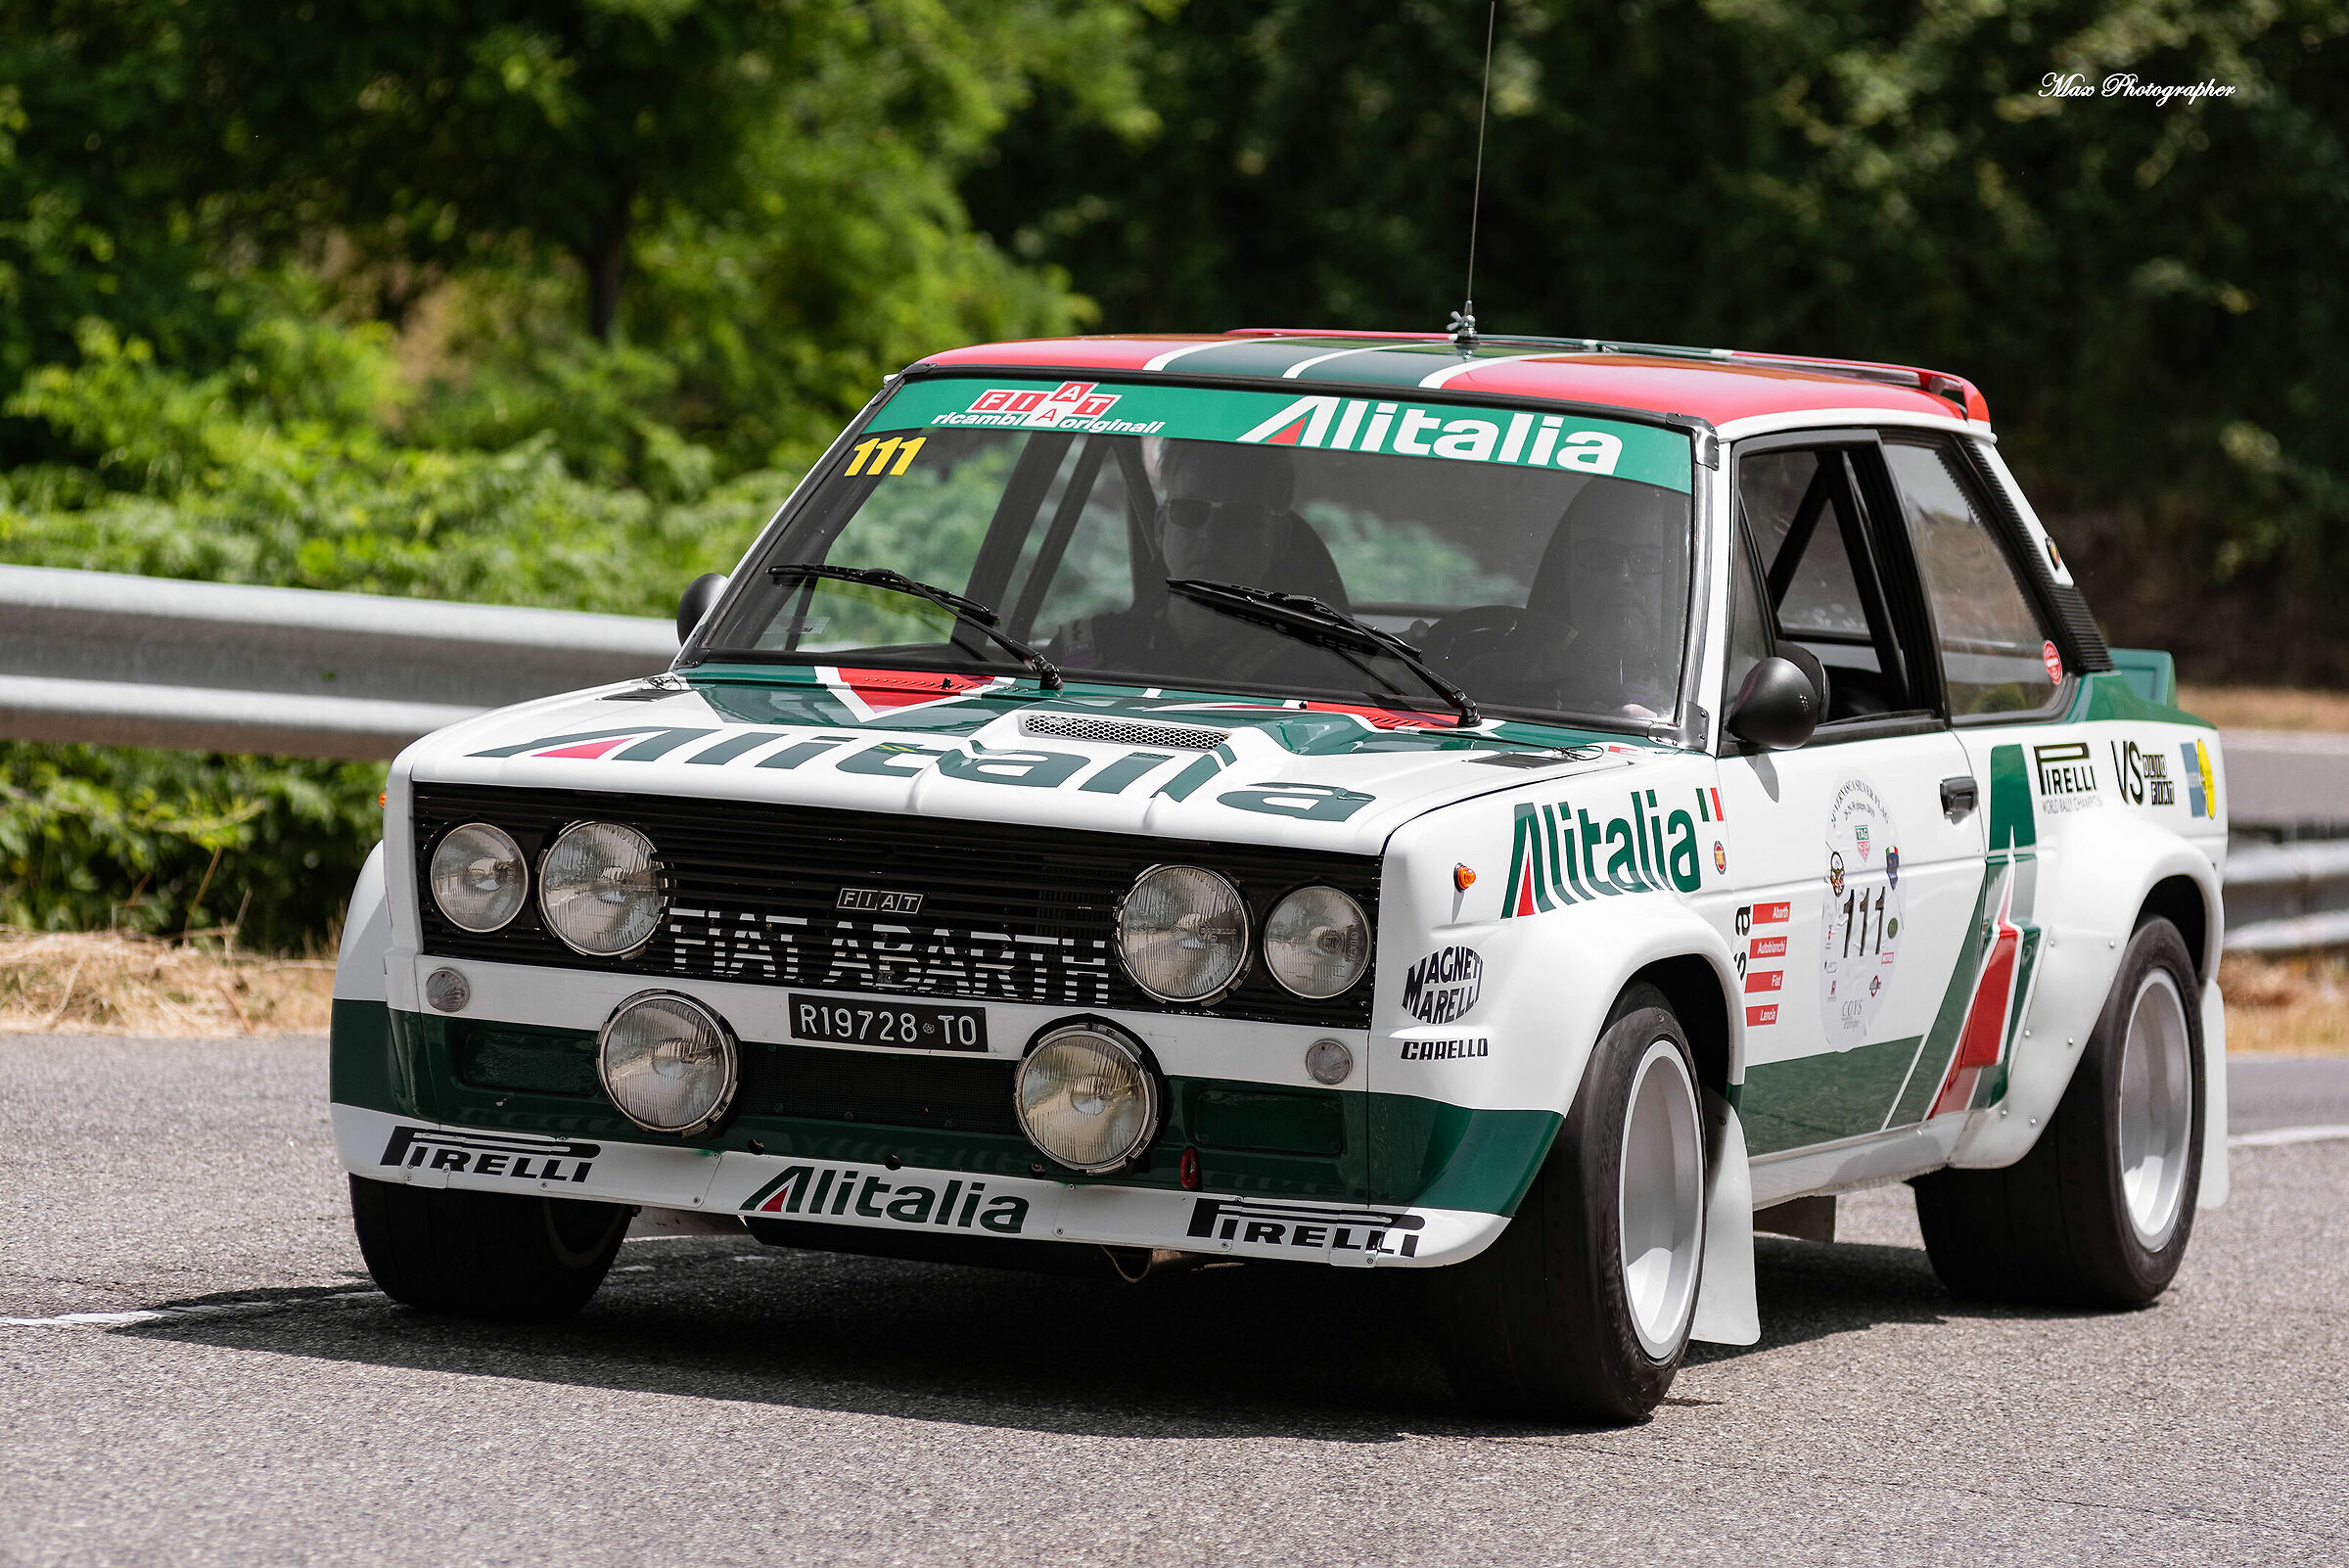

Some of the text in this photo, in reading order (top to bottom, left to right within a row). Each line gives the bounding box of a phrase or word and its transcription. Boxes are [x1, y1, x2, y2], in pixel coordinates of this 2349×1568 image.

[931, 410, 1167, 435] ricambi originali
[1236, 395, 1625, 476] Alitalia
[844, 437, 928, 477] 111
[465, 726, 1377, 822] Alitalia
[2033, 742, 2097, 796] PIRELLI
[2110, 740, 2143, 806] VS
[1500, 789, 1702, 920] Alitalia
[842, 890, 919, 913] FIAT
[1773, 906, 1790, 920] Abarth
[1842, 886, 1885, 959] 111
[668, 907, 1108, 1004] FIAT ABARTH
[1404, 945, 1484, 996] MAGNETI
[1757, 938, 1786, 956] Autobianchi
[1772, 972, 1782, 988] Fiat
[799, 1002, 977, 1046] R19728 TO
[1401, 983, 1482, 1025] MARELLI
[1760, 1007, 1776, 1022] Lancia
[1842, 998, 1864, 1018] COYS
[1401, 1038, 1489, 1061] CARELLO
[380, 1126, 601, 1183] PIRELLI
[738, 1164, 1030, 1234] Alitalia
[1186, 1197, 1425, 1260] PIRELLI
